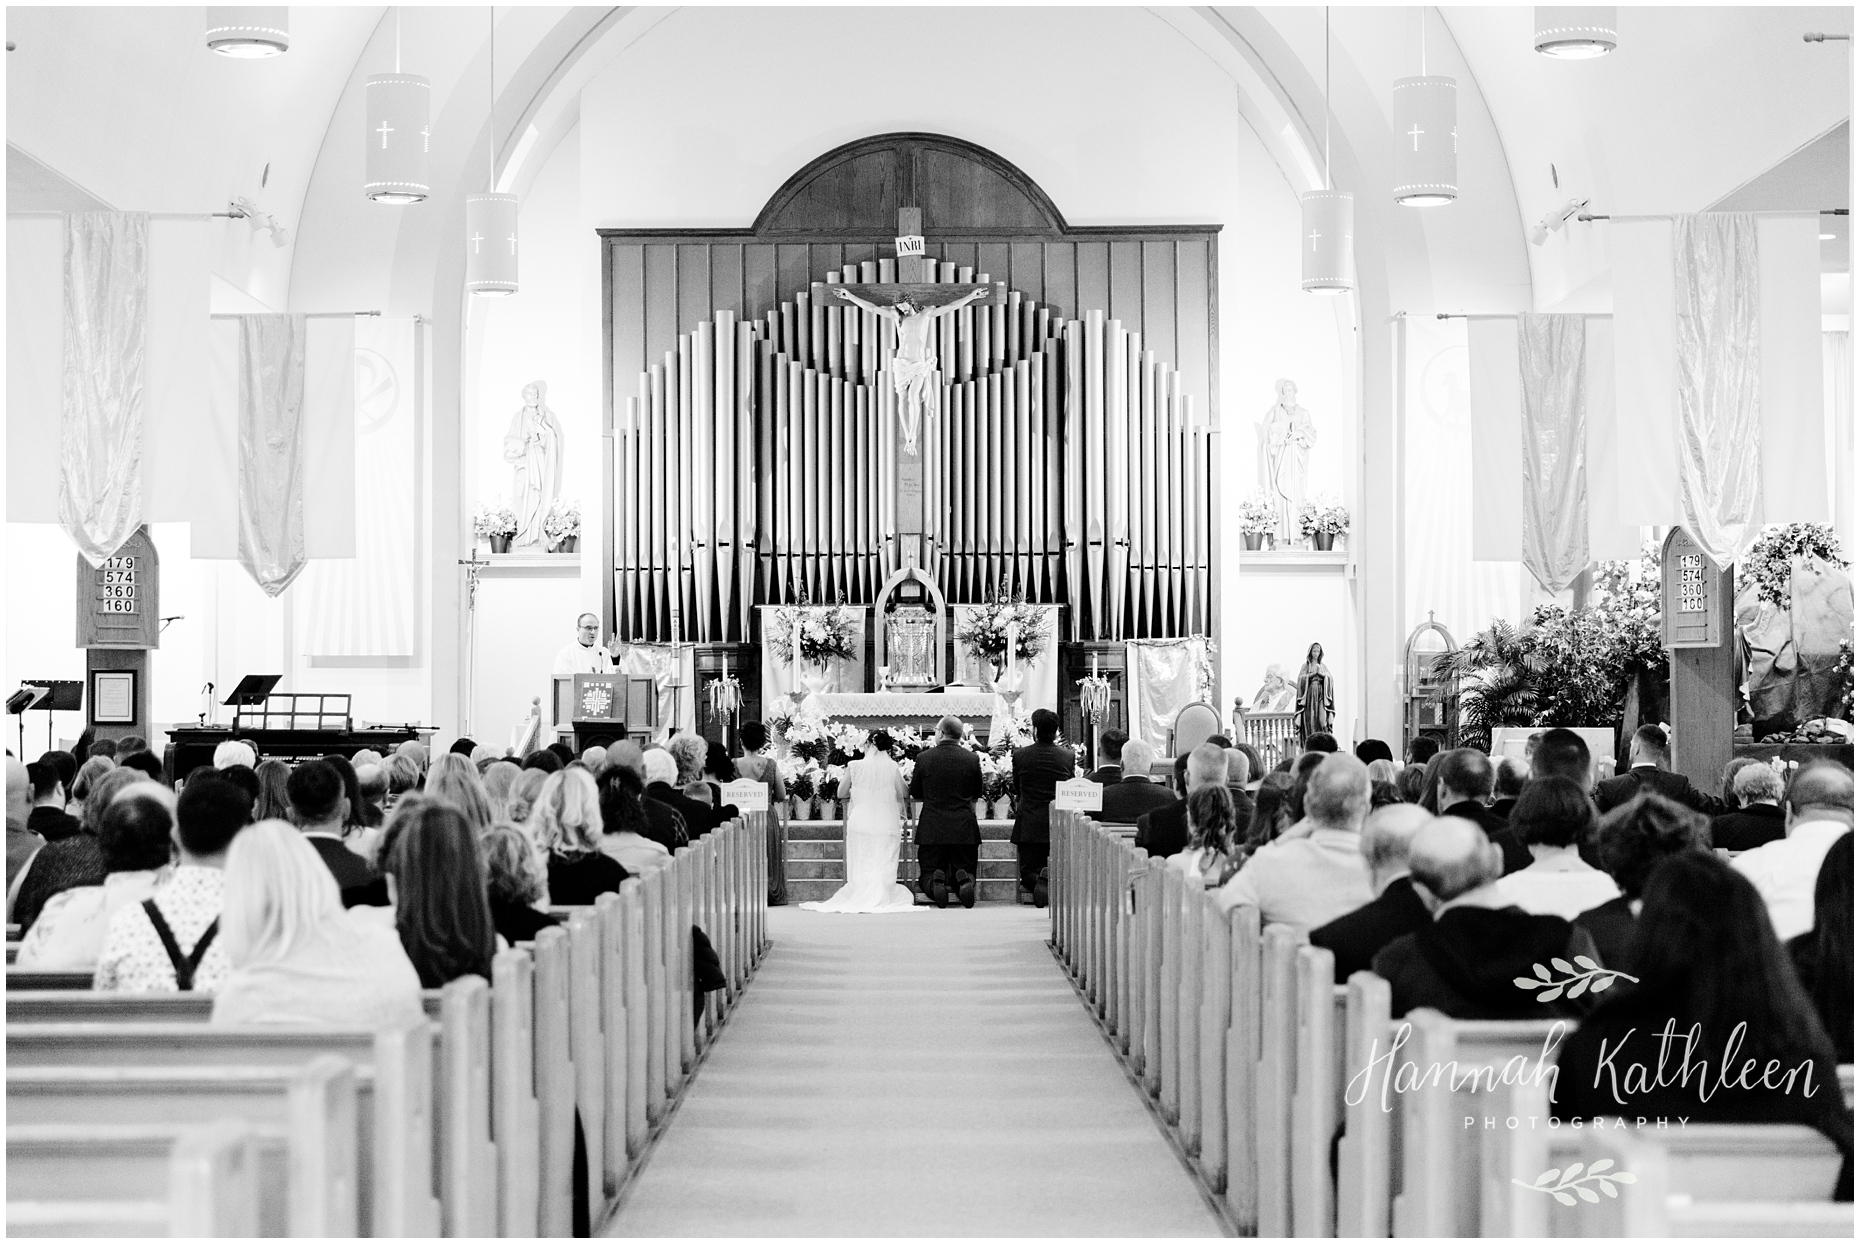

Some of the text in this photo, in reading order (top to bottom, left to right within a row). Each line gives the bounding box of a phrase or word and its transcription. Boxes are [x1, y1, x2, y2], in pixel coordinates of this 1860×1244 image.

[899, 240, 921, 252] INRI
[107, 557, 133, 569] 179
[1681, 555, 1700, 568] 179
[106, 571, 133, 583] 574
[1682, 569, 1701, 581] 574
[105, 585, 133, 598] 360
[1682, 584, 1702, 596] 360
[105, 600, 132, 612] 160
[1061, 790, 1098, 798] RESERVED
